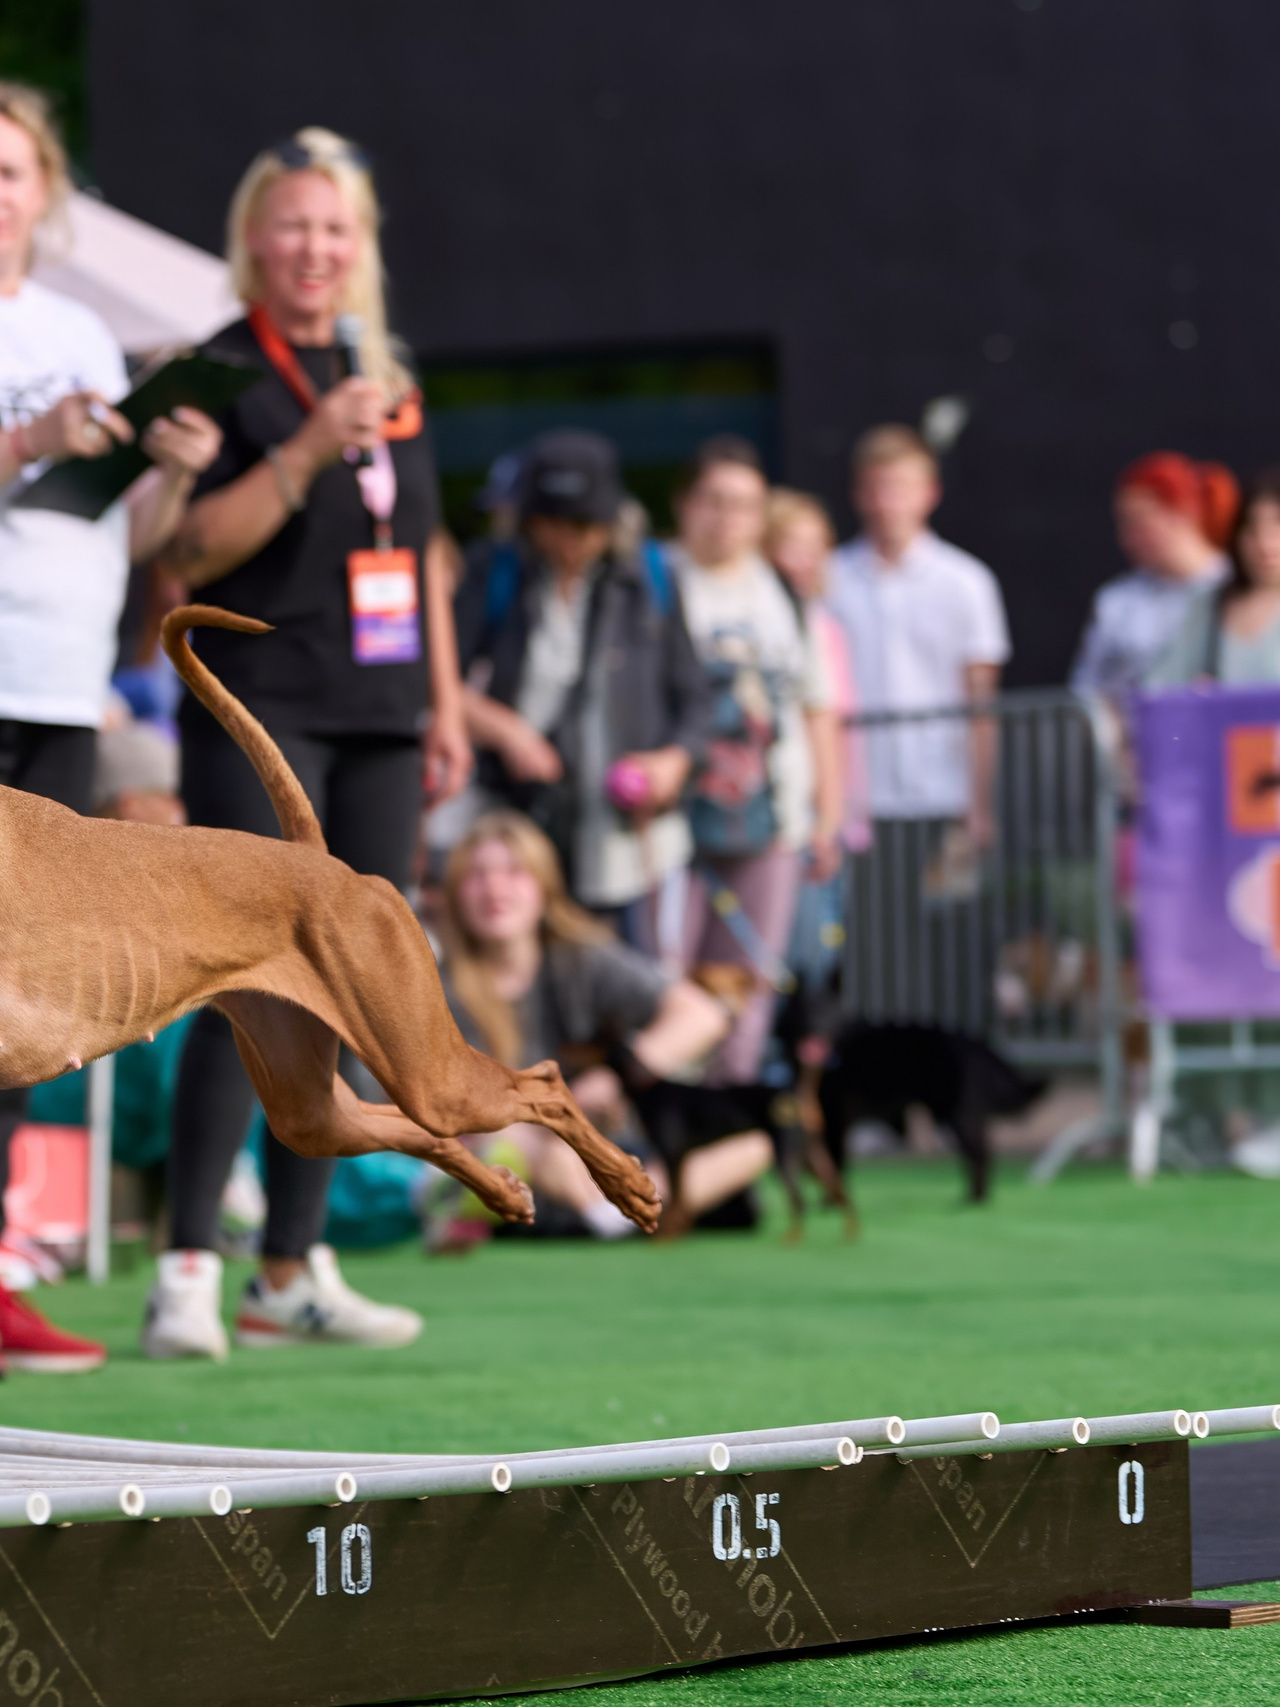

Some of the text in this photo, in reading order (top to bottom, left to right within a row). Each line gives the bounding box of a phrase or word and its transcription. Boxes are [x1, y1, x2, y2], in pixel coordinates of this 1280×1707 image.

[712, 1492, 781, 1561] 0.5
[1118, 1460, 1144, 1524] 0
[611, 1482, 711, 1643] Plywood
